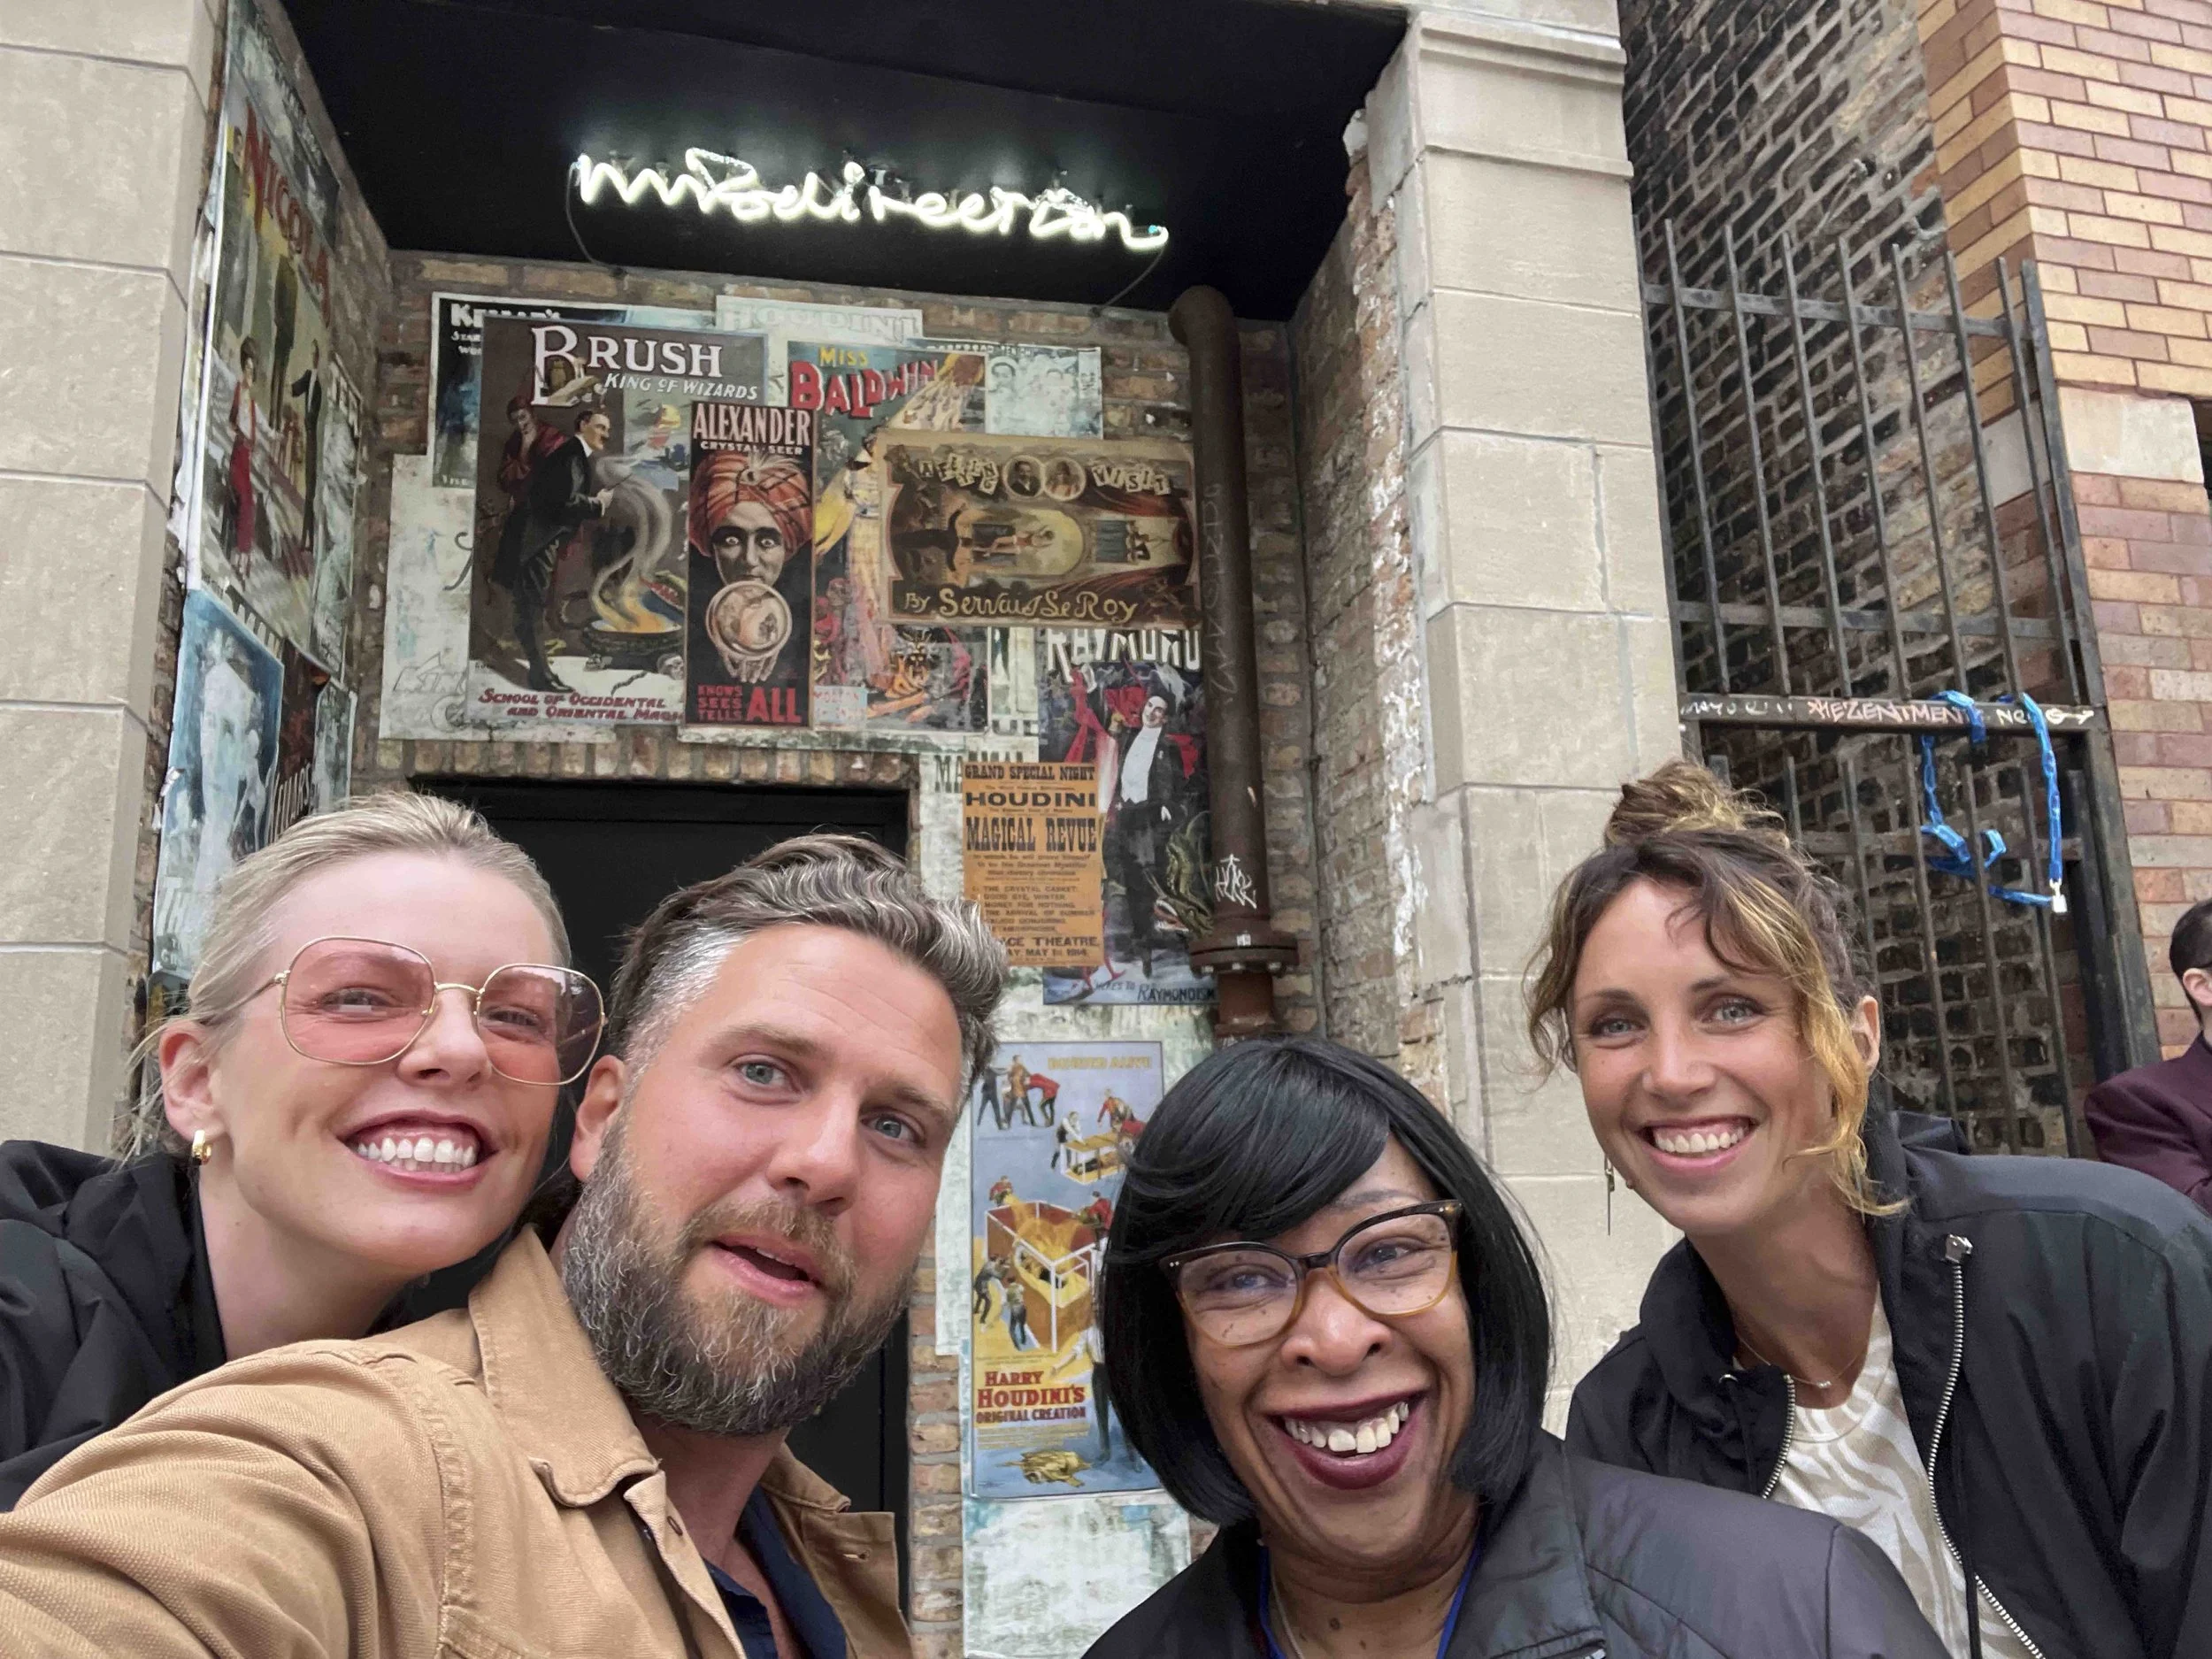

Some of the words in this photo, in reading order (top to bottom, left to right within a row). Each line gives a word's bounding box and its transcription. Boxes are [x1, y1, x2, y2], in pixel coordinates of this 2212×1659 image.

[572, 147, 1169, 250] misdirection
[531, 325, 723, 406] BRUSH
[819, 346, 870, 368] MISS
[604, 373, 651, 392] KING
[657, 379, 679, 394] OF
[683, 380, 758, 400] WIZARDS
[790, 359, 939, 419] BALDWIN
[693, 403, 811, 446] ALEXANDER
[479, 687, 539, 705] SCHOOL
[568, 692, 667, 709] OCCIDENTAL
[697, 697, 743, 709] SEES
[745, 687, 803, 724] ALL
[545, 707, 626, 720] ORIENTAL
[697, 710, 743, 721] TELLS
[964, 764, 1005, 780] GRAND
[1010, 765, 1056, 780] SPECIAL
[1059, 765, 1095, 781] NIGHT
[965, 791, 1096, 807] HOUDINI
[966, 816, 1036, 852] MAGICAL
[1046, 817, 1097, 853] REVUE
[1137, 984, 1217, 1002] RAYMONDISM
[985, 1371, 1044, 1386] HARRY
[978, 1384, 1086, 1409] HOUDINI'S
[976, 1409, 1030, 1424] ORIGINAL
[1032, 1406, 1087, 1421] CREATION
